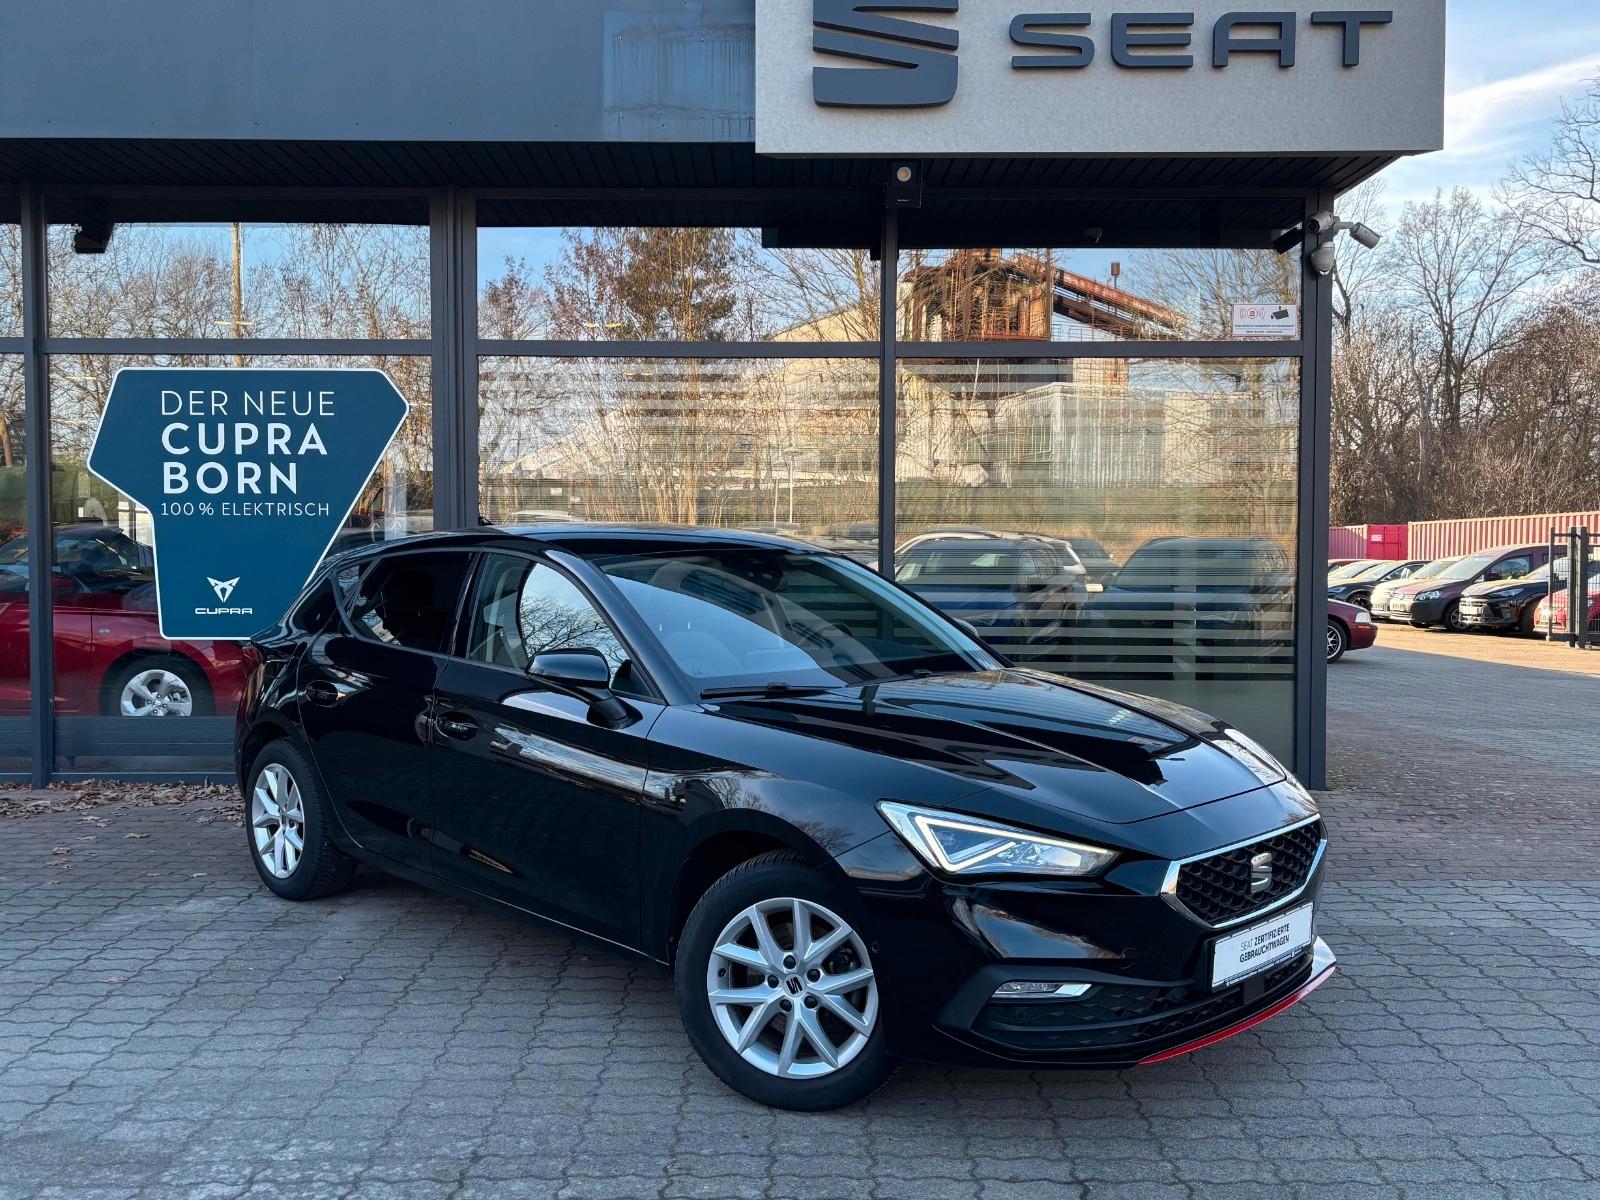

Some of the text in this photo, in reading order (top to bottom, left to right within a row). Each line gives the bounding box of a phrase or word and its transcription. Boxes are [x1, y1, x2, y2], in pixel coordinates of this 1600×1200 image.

[1009, 10, 1394, 69] SEAT
[161, 390, 335, 416] DER NEUE
[161, 422, 328, 455] CUPRA
[163, 461, 297, 495] BORN
[161, 502, 329, 516] 100 % ELEKTRISCH
[194, 607, 253, 615] CUPRA
[1239, 934, 1290, 963] GEBRAUCHTWAGEN
[1240, 922, 1290, 952] SEAT ZERTIFIZIERTE
